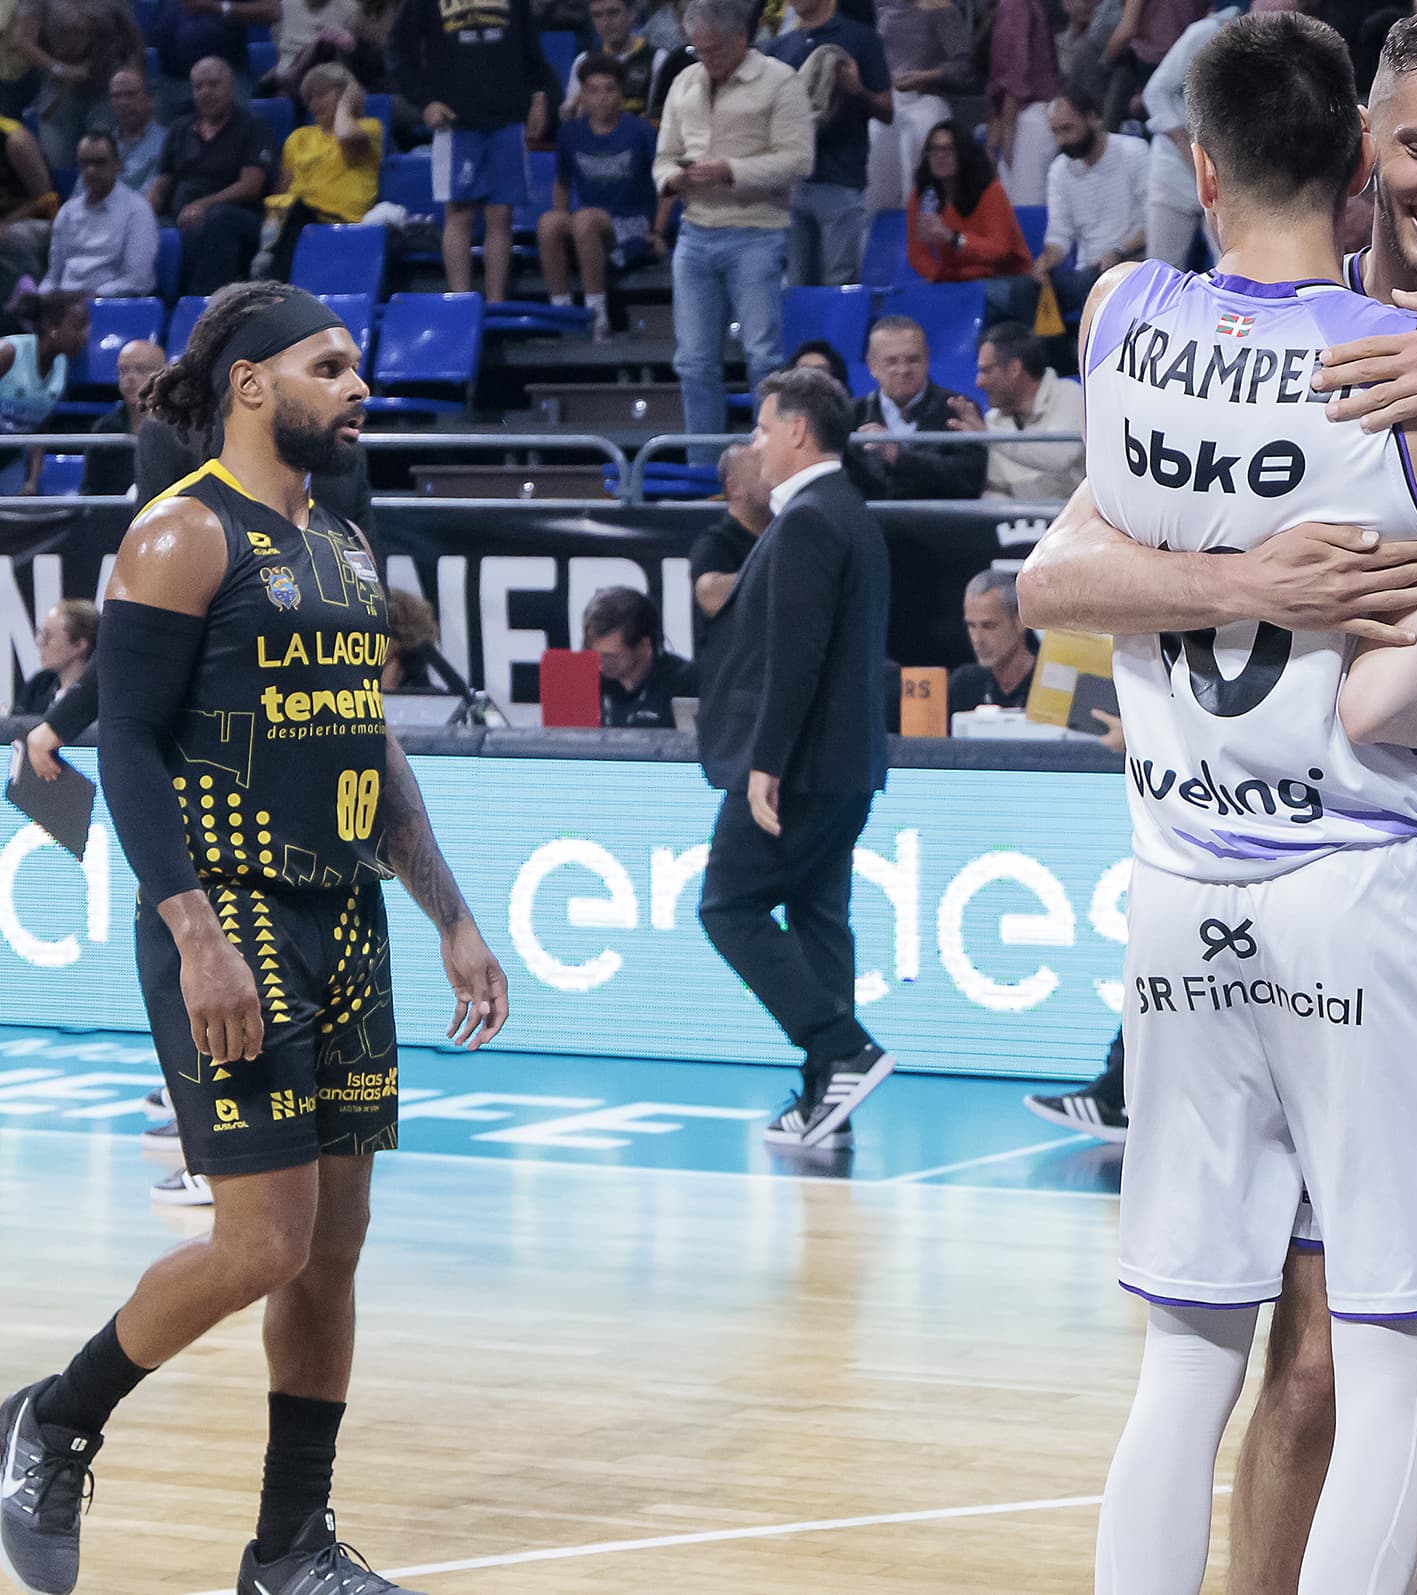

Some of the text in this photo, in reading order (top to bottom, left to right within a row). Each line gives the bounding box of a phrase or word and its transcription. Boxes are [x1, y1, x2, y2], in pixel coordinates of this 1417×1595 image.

[1116, 318, 1351, 404] KRAMPEL
[257, 631, 390, 667] LA LAGUN
[260, 678, 384, 723] tenerif
[267, 723, 345, 740] despierta
[336, 769, 380, 841] 88
[1136, 975, 1363, 1026] SR Financial
[318, 1086, 382, 1101] anarias
[347, 1072, 382, 1088] Islas
